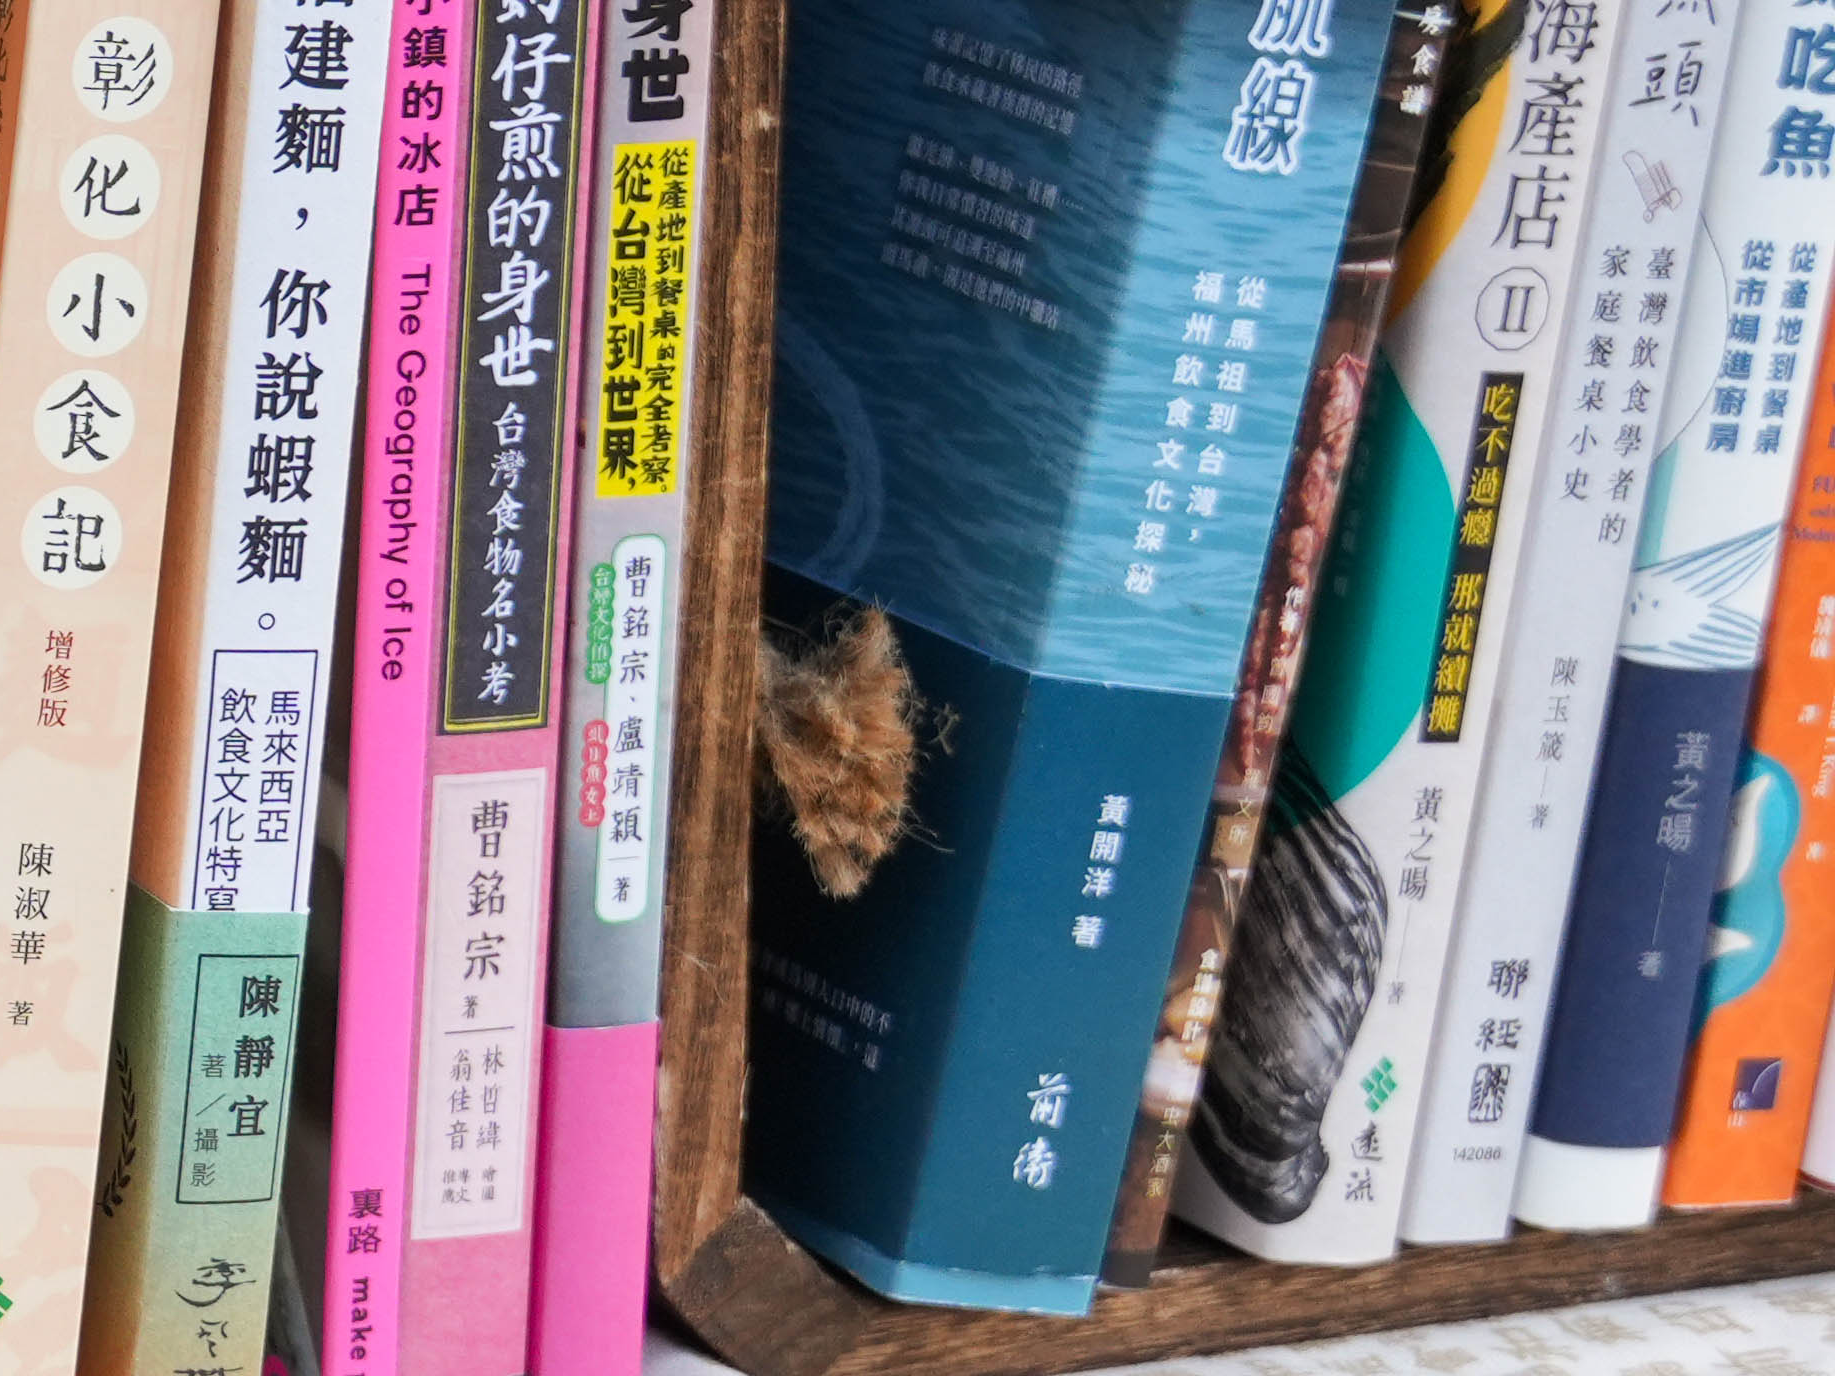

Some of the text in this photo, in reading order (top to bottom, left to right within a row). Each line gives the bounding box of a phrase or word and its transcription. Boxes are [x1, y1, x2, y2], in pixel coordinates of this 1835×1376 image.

[42, 30, 156, 575] 彰化小食記
[599, 151, 655, 492] 從台灣到世界，
[1561, 245, 1632, 503] 家庭餐桌小史
[1752, 241, 1819, 455] 從產地到餐桌
[379, 263, 432, 684] The Geography of Ice
[1188, 275, 1267, 545] 從馬祖到台灣，
[1460, 383, 1516, 546] 吃不過癮
[1598, 245, 1674, 544] 臺灣飲食學者的
[477, 401, 529, 705] 台灣食物名小考
[37, 629, 74, 728] 增修版
[253, 690, 302, 844] 馬來西亞
[1530, 803, 1551, 831] 著
[7, 842, 54, 1027] 陳淑華 著
[461, 799, 510, 1021] 曹銘宗 著
[611, 876, 631, 904] 著
[1071, 793, 1132, 948] 黃開洋 著
[226, 974, 282, 1138] 陳靜宜
[1388, 981, 1405, 1005] 著
[446, 1048, 472, 1151] 翁佳音
[348, 1276, 372, 1361] make
